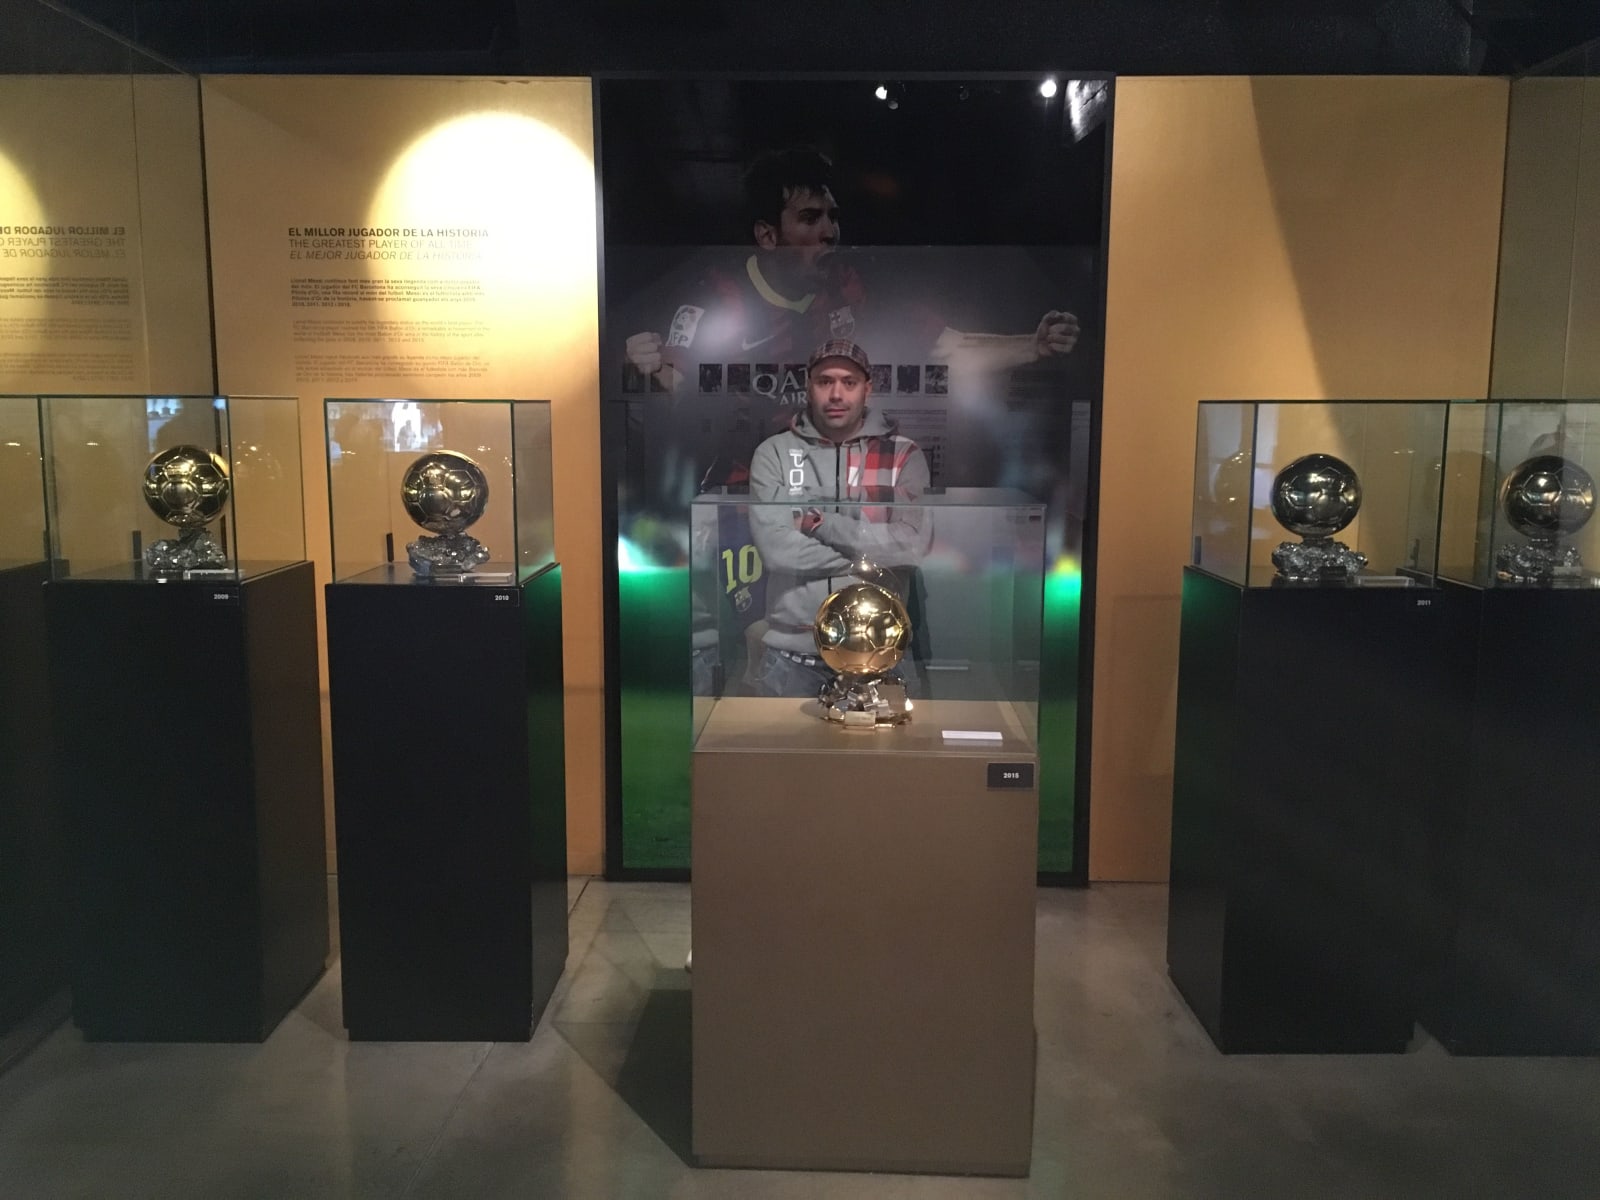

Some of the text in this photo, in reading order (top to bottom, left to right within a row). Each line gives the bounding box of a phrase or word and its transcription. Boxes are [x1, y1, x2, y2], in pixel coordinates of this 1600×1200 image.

[288, 228, 489, 237] EL MILLOR JUGADOR DE LA HISTORIA
[289, 239, 309, 248] THE
[312, 239, 365, 248] GREATEST
[369, 240, 407, 248] PLAYER
[290, 251, 303, 259] EL
[306, 251, 342, 259] MEJOR
[344, 251, 396, 260] JUGADOR
[400, 251, 413, 260] DE
[722, 545, 762, 594] 10
